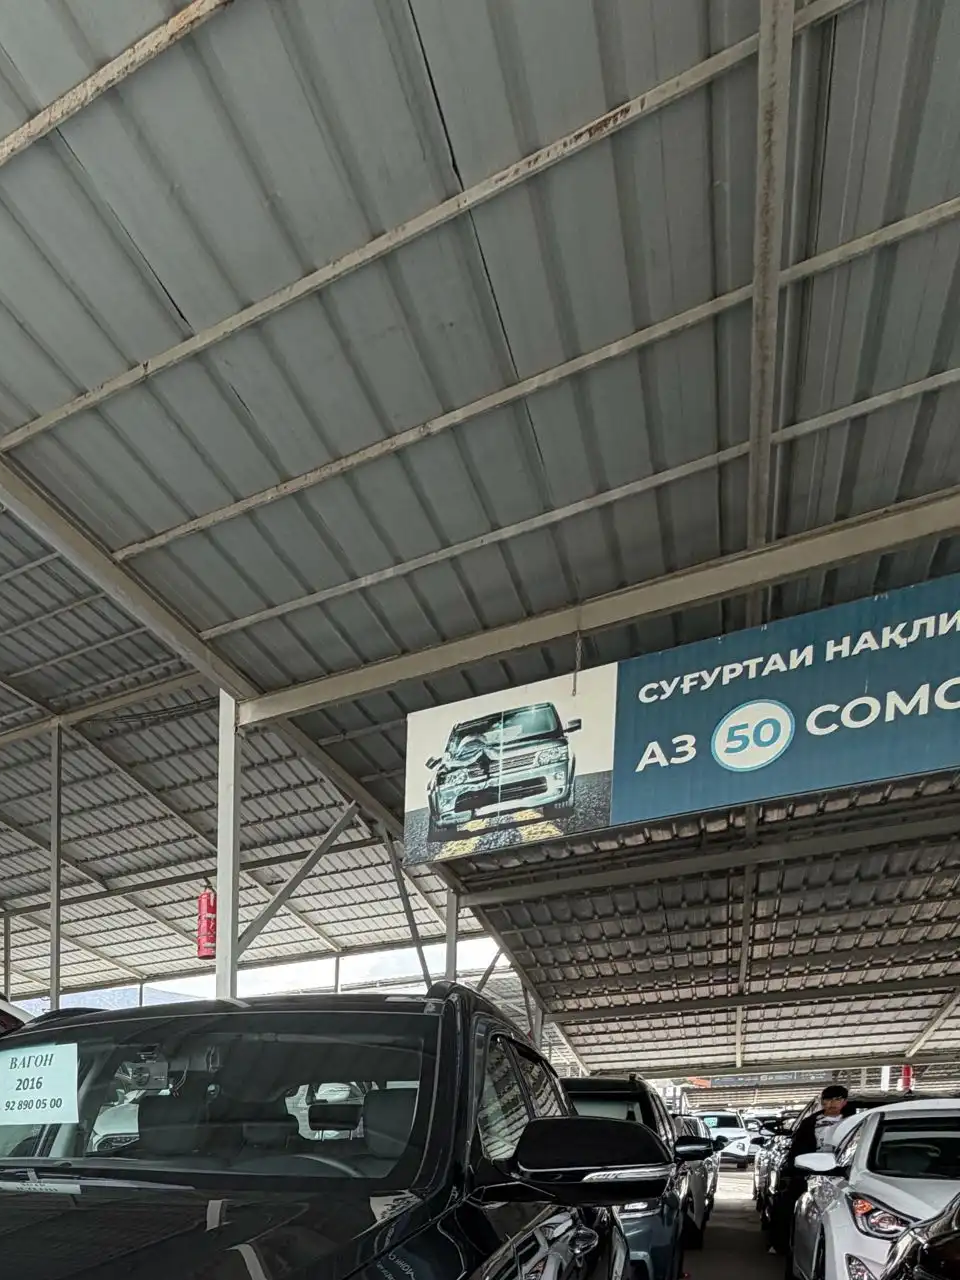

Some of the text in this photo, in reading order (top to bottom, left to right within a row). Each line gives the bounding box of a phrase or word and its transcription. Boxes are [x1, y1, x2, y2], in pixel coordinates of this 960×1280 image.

[635, 734, 697, 773] АЗ
[724, 718, 782, 754] 50
[9, 1054, 54, 1069] ВАГОН
[15, 1076, 43, 1091] 2016
[4, 1098, 63, 1111] 92 890 05 00
